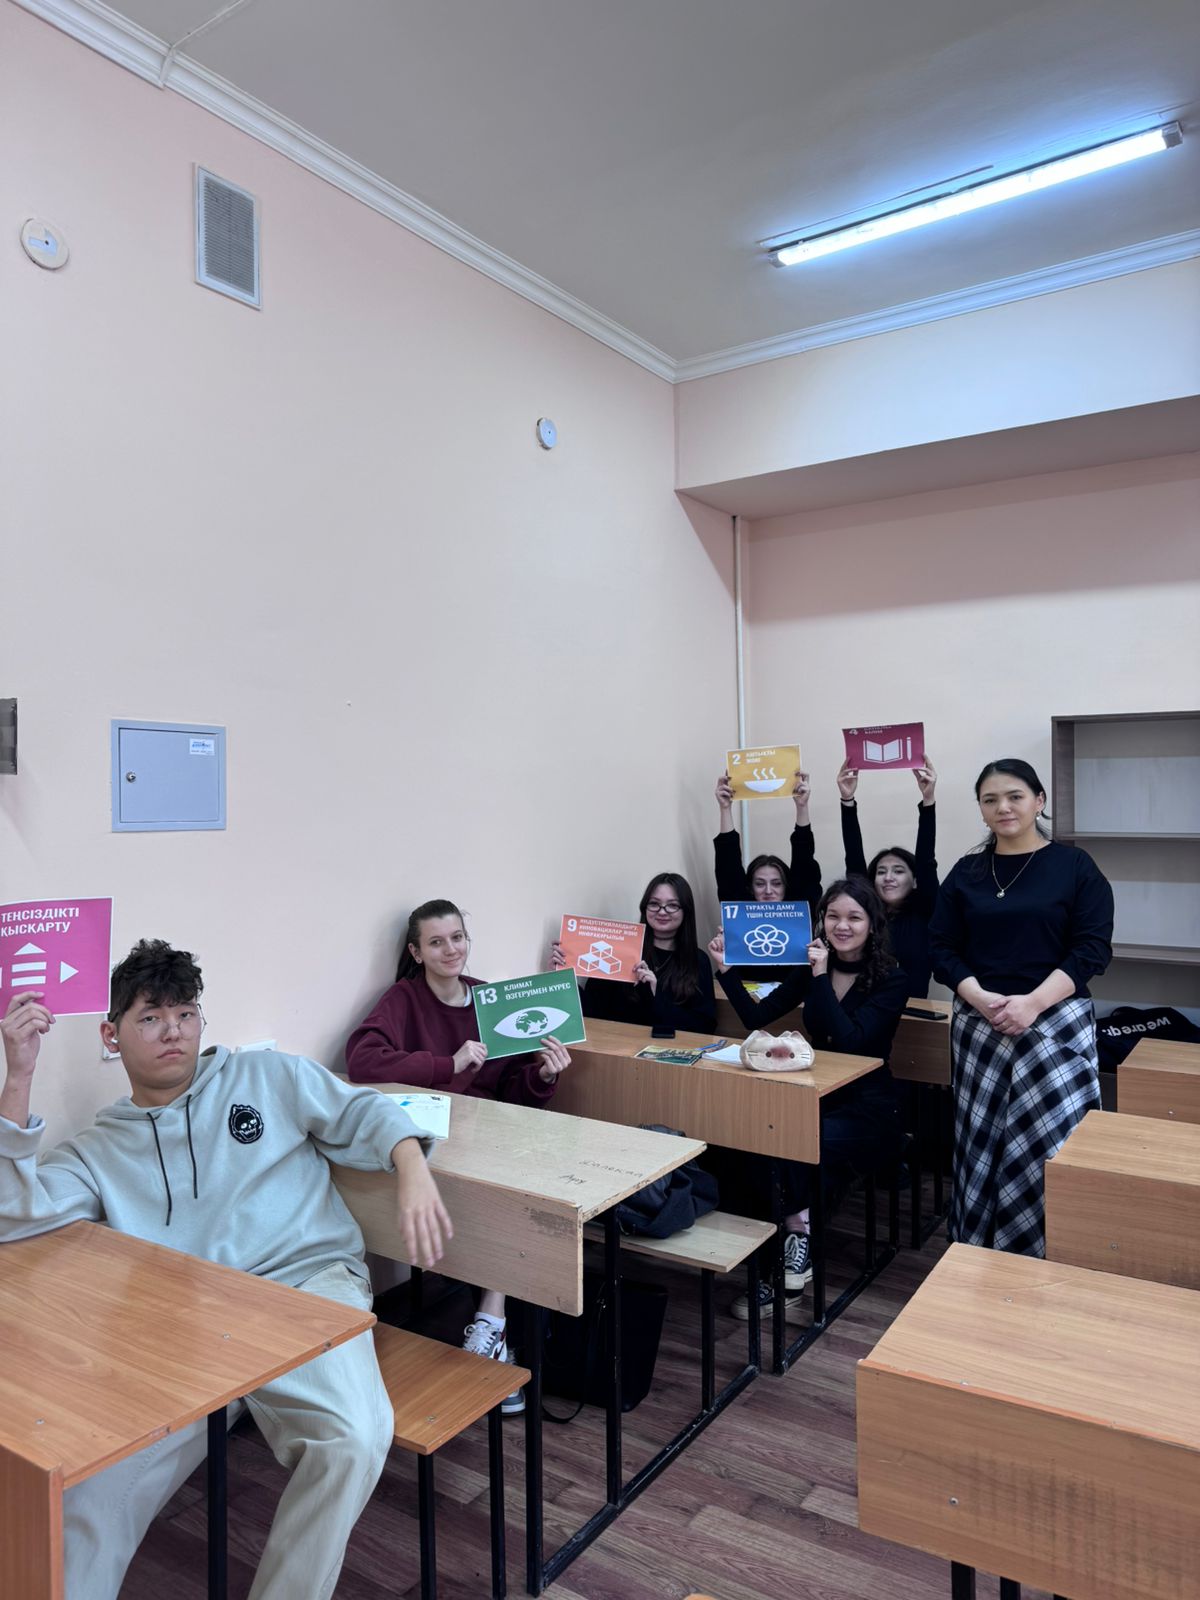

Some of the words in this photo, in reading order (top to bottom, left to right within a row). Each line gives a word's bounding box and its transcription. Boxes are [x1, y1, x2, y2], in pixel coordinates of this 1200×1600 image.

[732, 753, 741, 765] 2
[1, 907, 80, 923] ТЕҢСІЗДІКТІ
[724, 905, 739, 919] 17
[1, 922, 71, 938] ҚЫСҚАРТУ
[567, 918, 577, 932] 9
[504, 980, 533, 992] КЛИМАТ
[505, 988, 548, 1001] ӨЗГЕРУІМЕН
[549, 982, 572, 993] КҮРЕС
[477, 988, 498, 1005] 13
